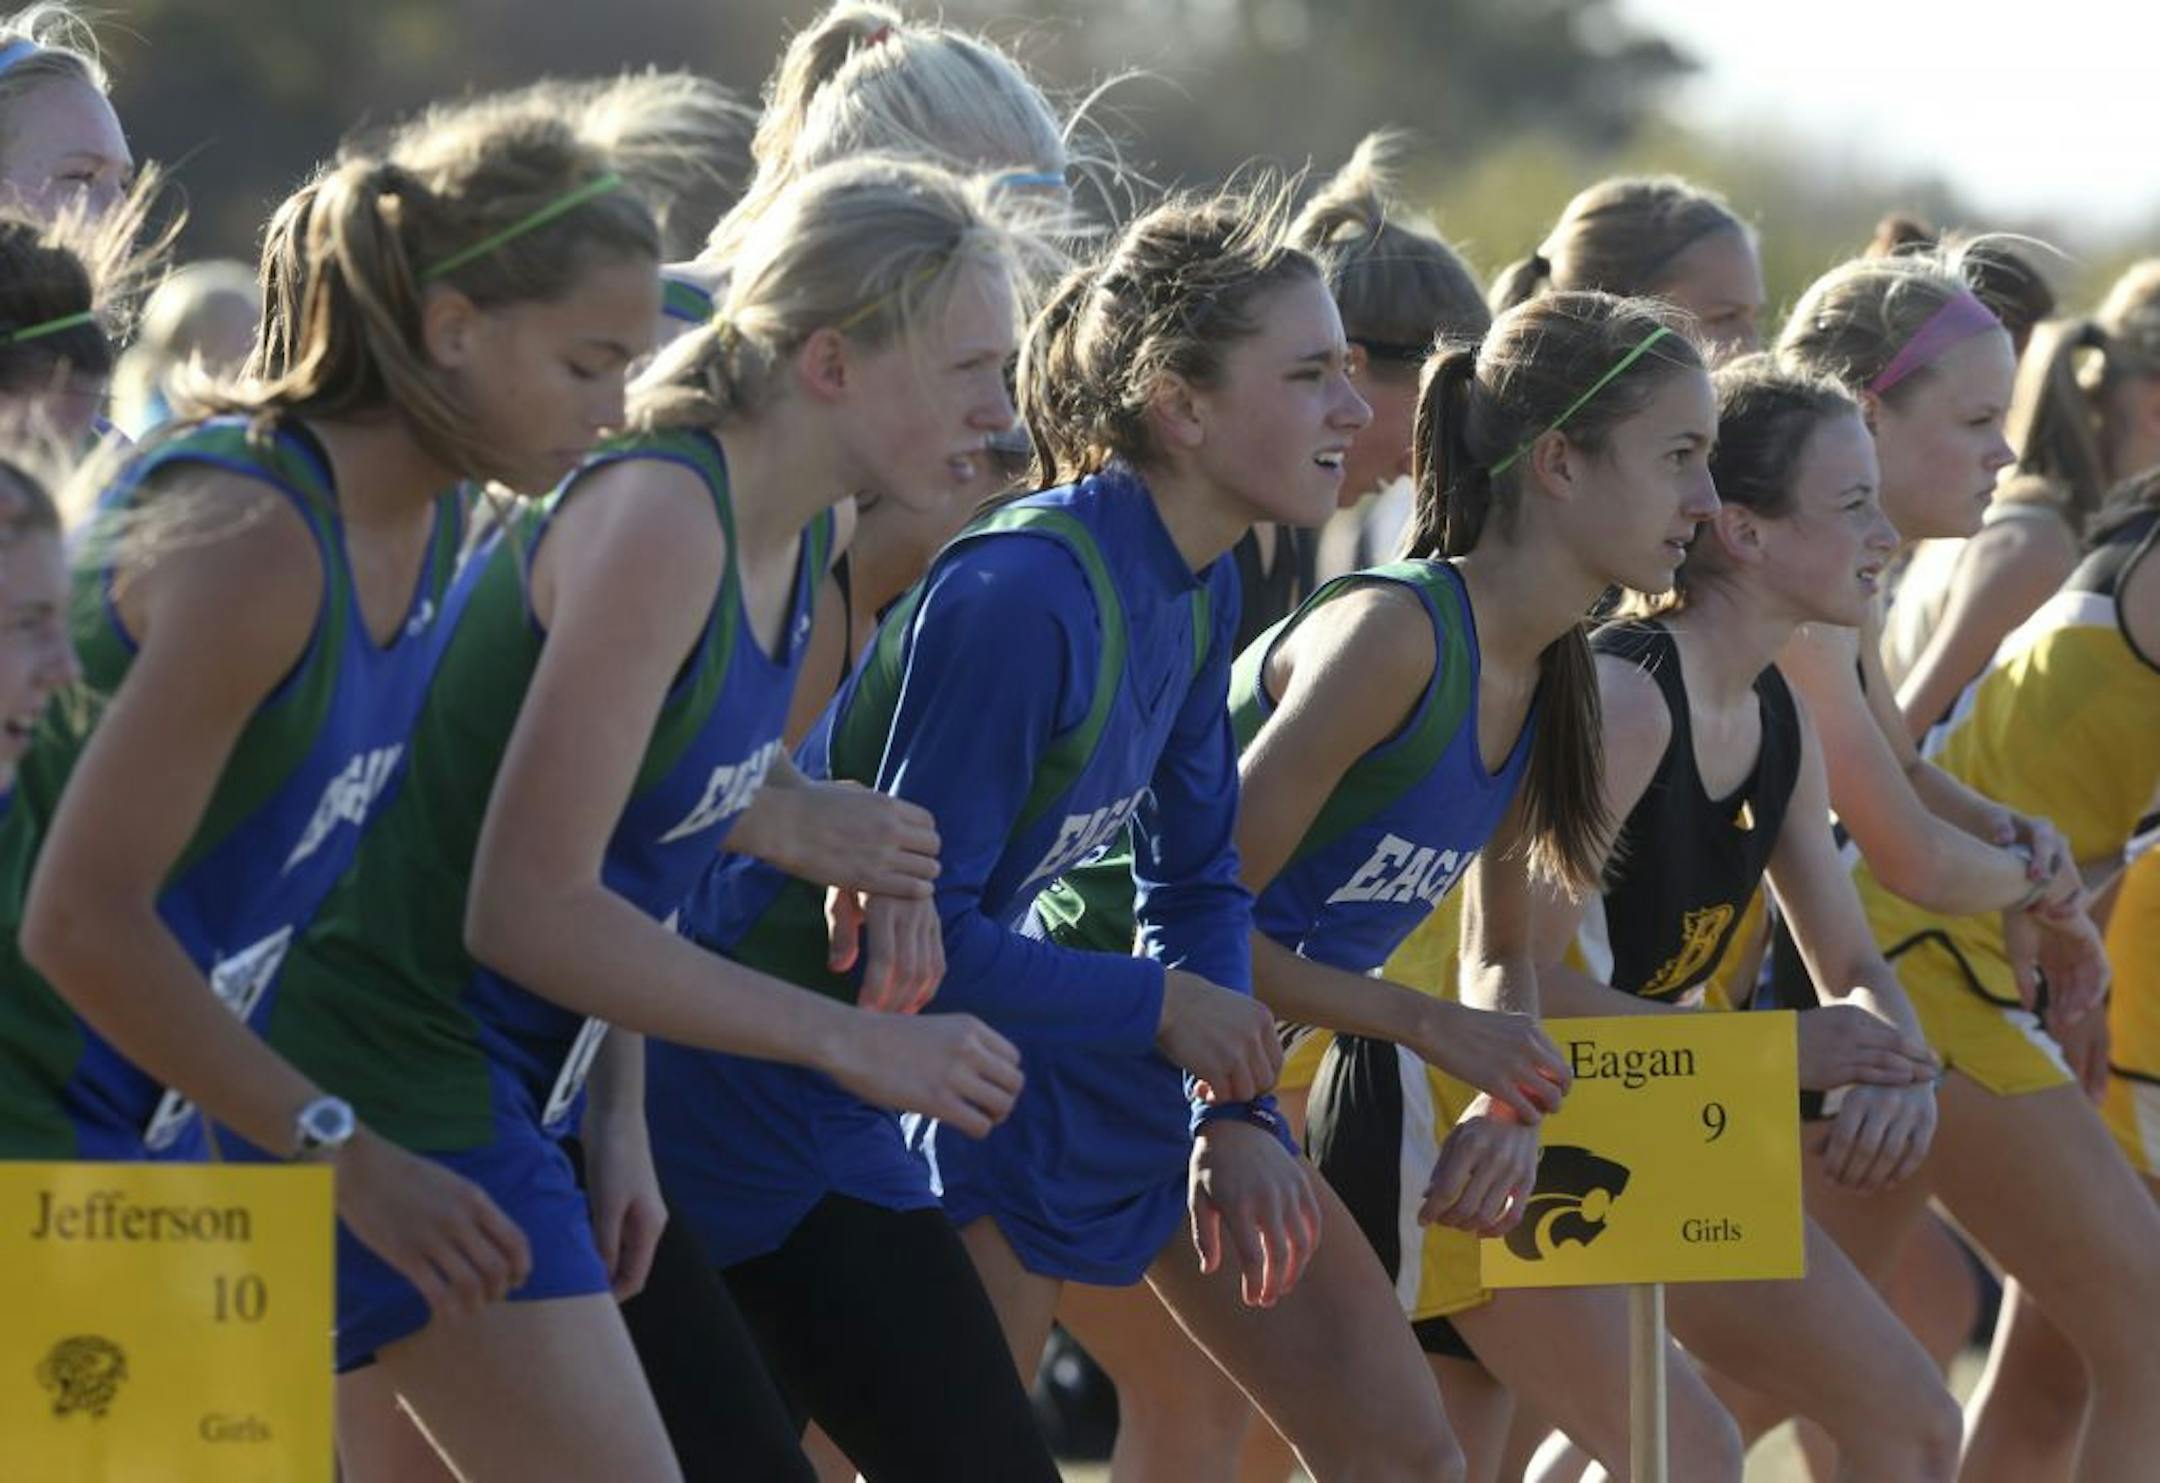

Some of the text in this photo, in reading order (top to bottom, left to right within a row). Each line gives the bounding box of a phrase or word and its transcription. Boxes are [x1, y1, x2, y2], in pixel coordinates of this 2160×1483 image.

[1569, 1040, 1694, 1089] Eagan
[1702, 1102, 1726, 1143] 9
[30, 1189, 252, 1242] Jefferson
[1682, 1219, 1742, 1242] Girls
[213, 1274, 268, 1323] 10
[199, 1412, 272, 1443] Girls
